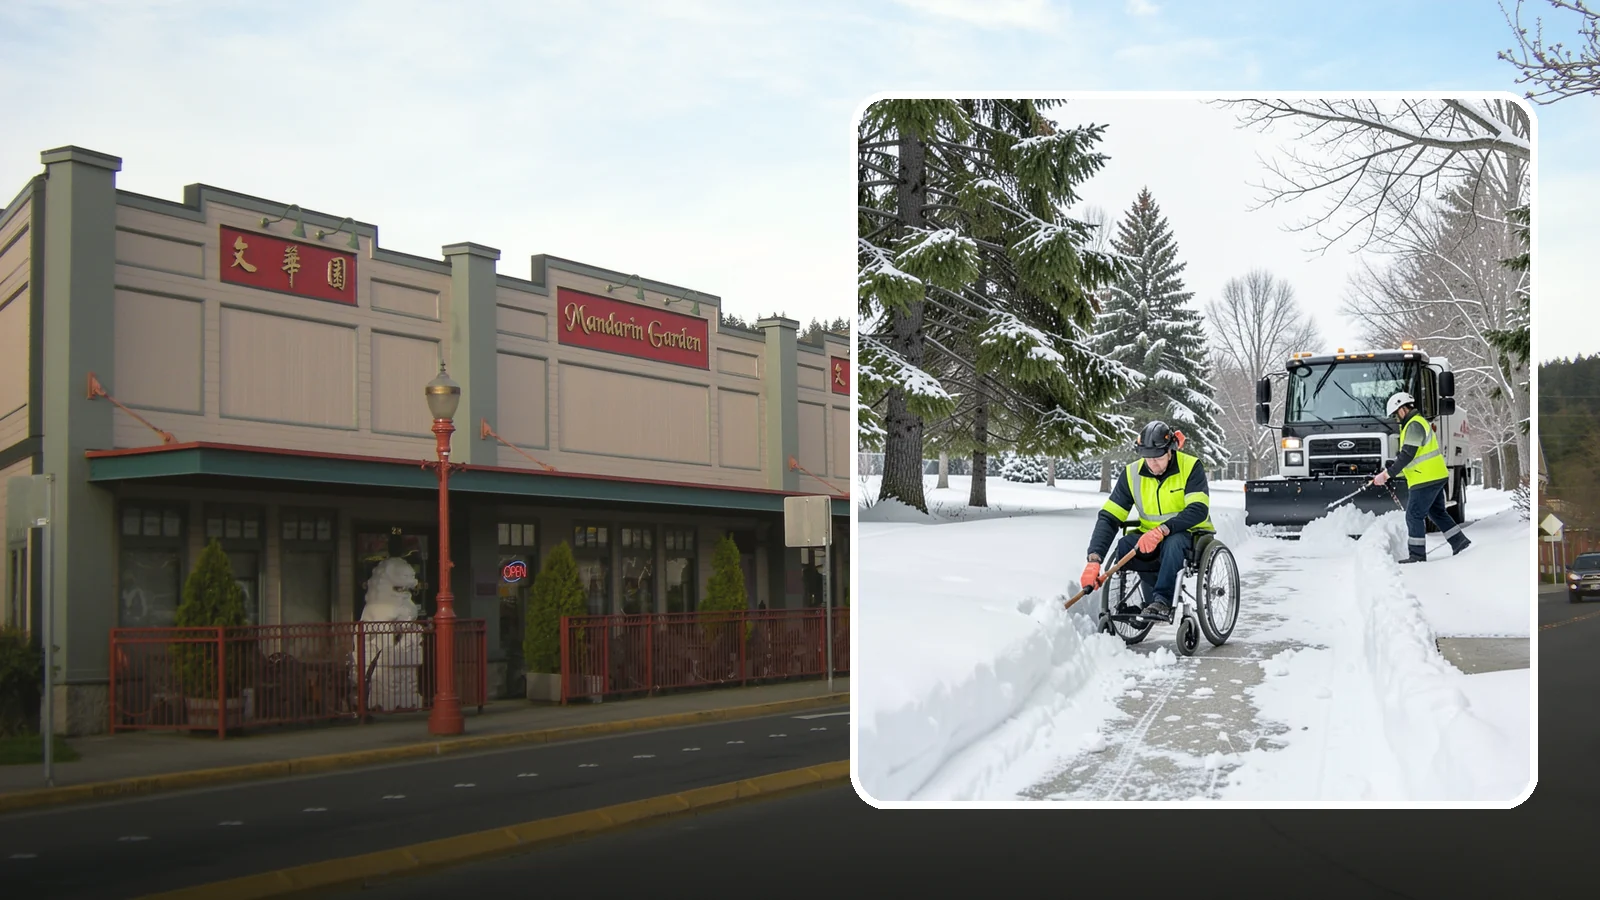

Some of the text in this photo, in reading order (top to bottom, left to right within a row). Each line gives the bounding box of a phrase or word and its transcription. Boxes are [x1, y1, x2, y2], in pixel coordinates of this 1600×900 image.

[231, 235, 346, 291] 文華園
[564, 302, 702, 352] Mandarin Garden
[503, 565, 527, 578] OPEN
